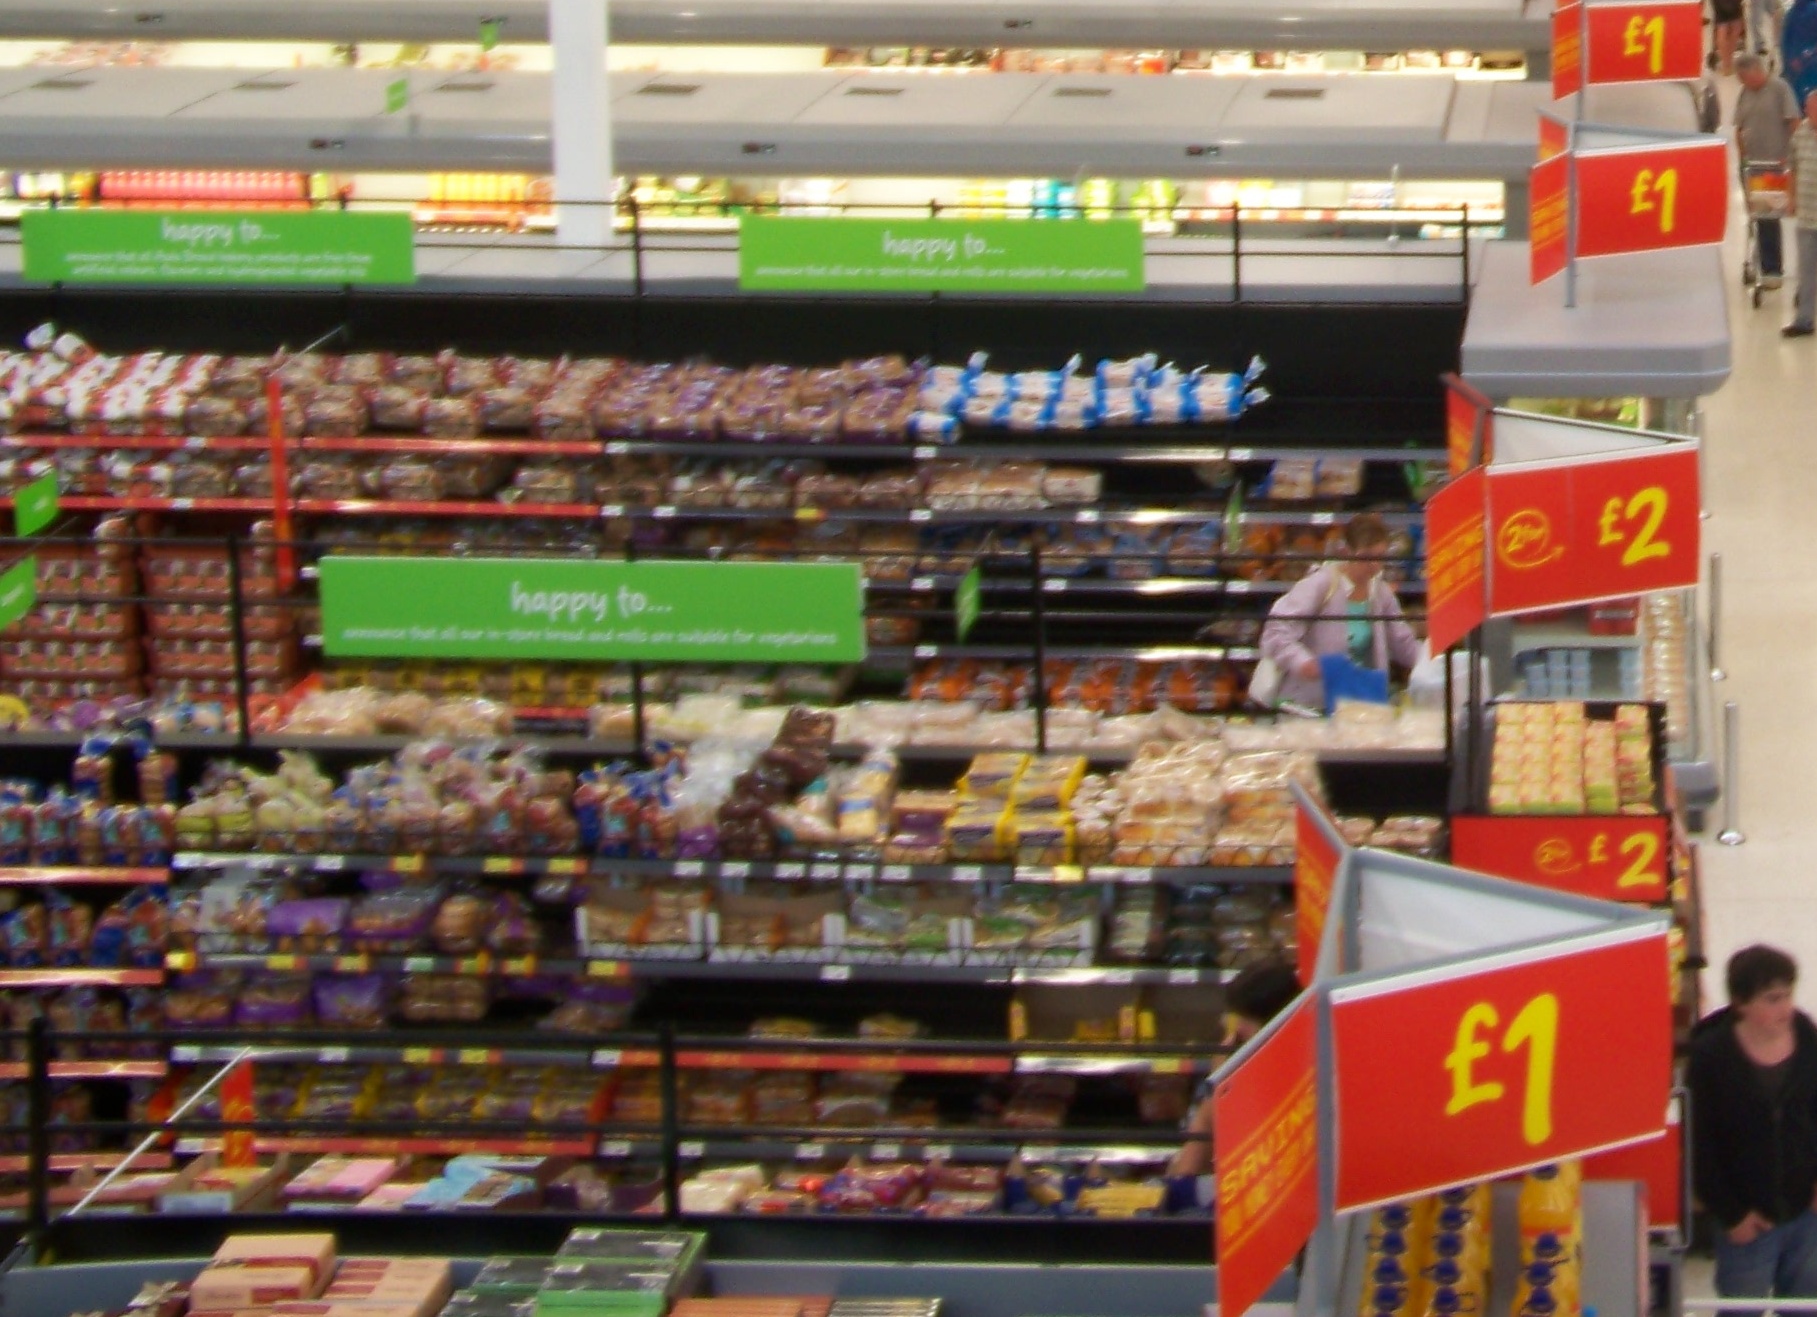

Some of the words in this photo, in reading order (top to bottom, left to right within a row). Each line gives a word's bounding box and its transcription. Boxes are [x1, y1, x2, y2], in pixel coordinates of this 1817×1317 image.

[1624, 14, 1666, 75] £1
[1629, 168, 1679, 235] £1
[161, 217, 234, 248] happy
[882, 230, 957, 263] happy
[1597, 485, 1672, 567] £2
[509, 580, 609, 623] happy
[1443, 992, 1561, 1148] £1
